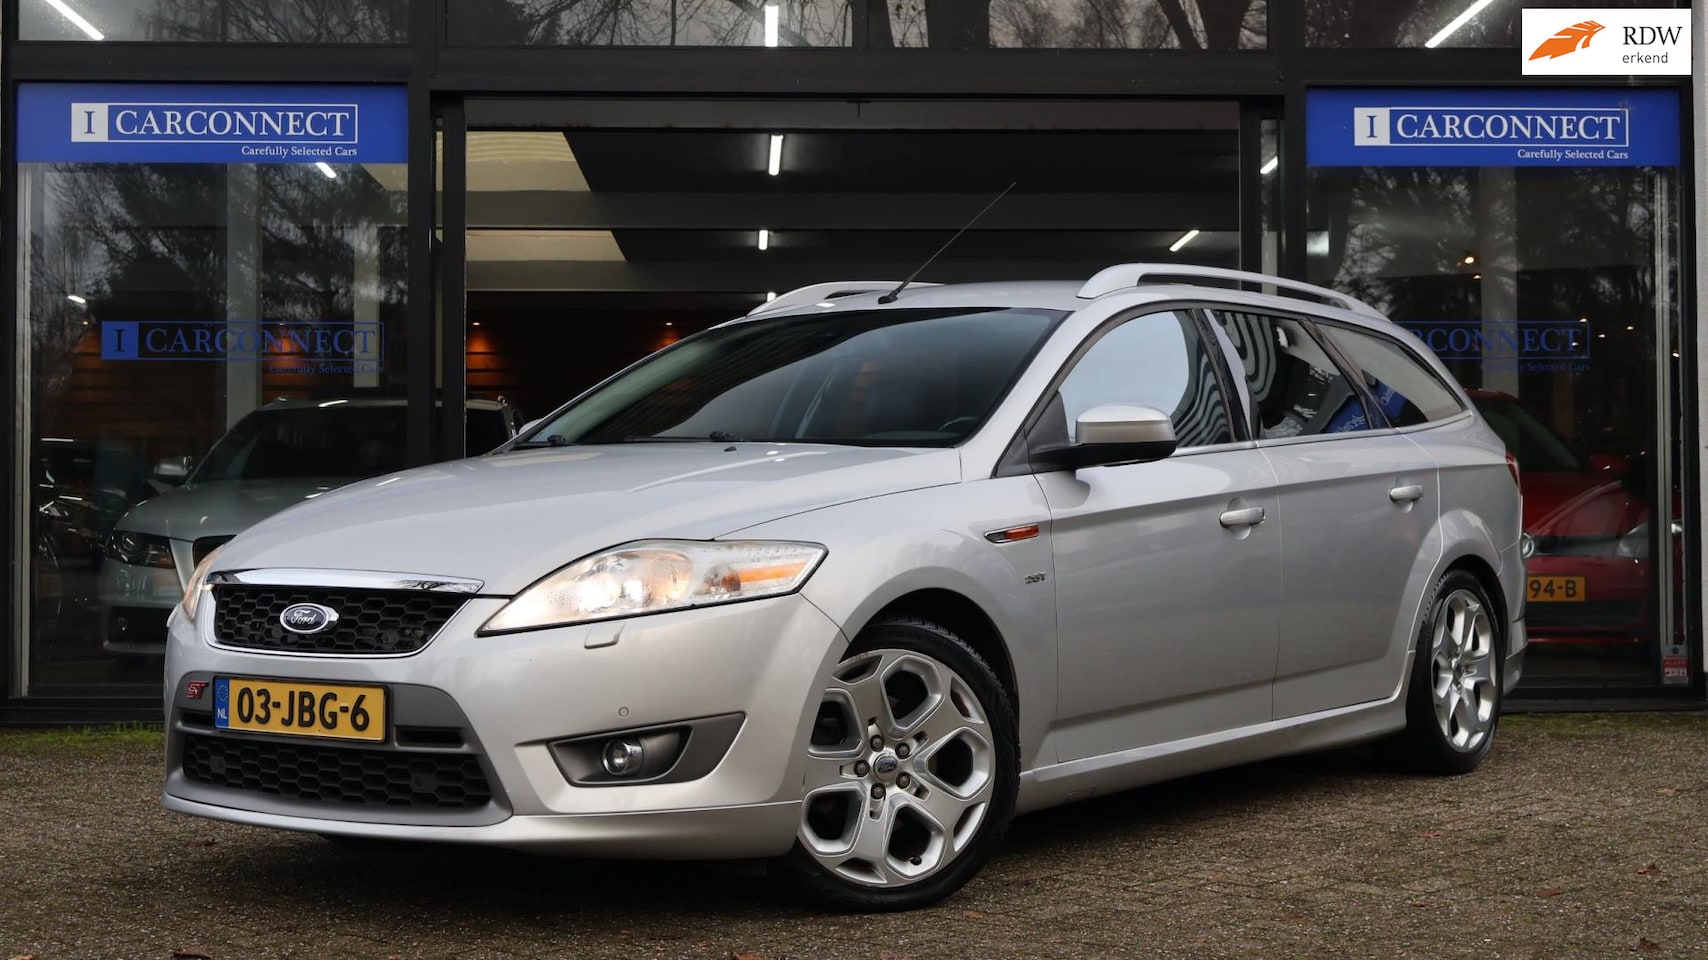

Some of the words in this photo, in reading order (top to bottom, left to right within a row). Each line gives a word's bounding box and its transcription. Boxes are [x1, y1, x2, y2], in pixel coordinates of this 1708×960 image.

[114, 109, 350, 136] CARCONNECT
[1396, 113, 1621, 140] CARCONNECT
[241, 145, 289, 159] Carefully
[290, 145, 332, 156] Selected
[334, 146, 358, 156] Cars
[1517, 148, 1563, 162] Carefully
[1564, 149, 1604, 159] Selected
[1606, 149, 1629, 160] Cars
[145, 327, 376, 354] CARCONNECT
[289, 610, 318, 625] Ford
[217, 707, 228, 720] NL
[236, 686, 370, 732] 03-JBG-6
